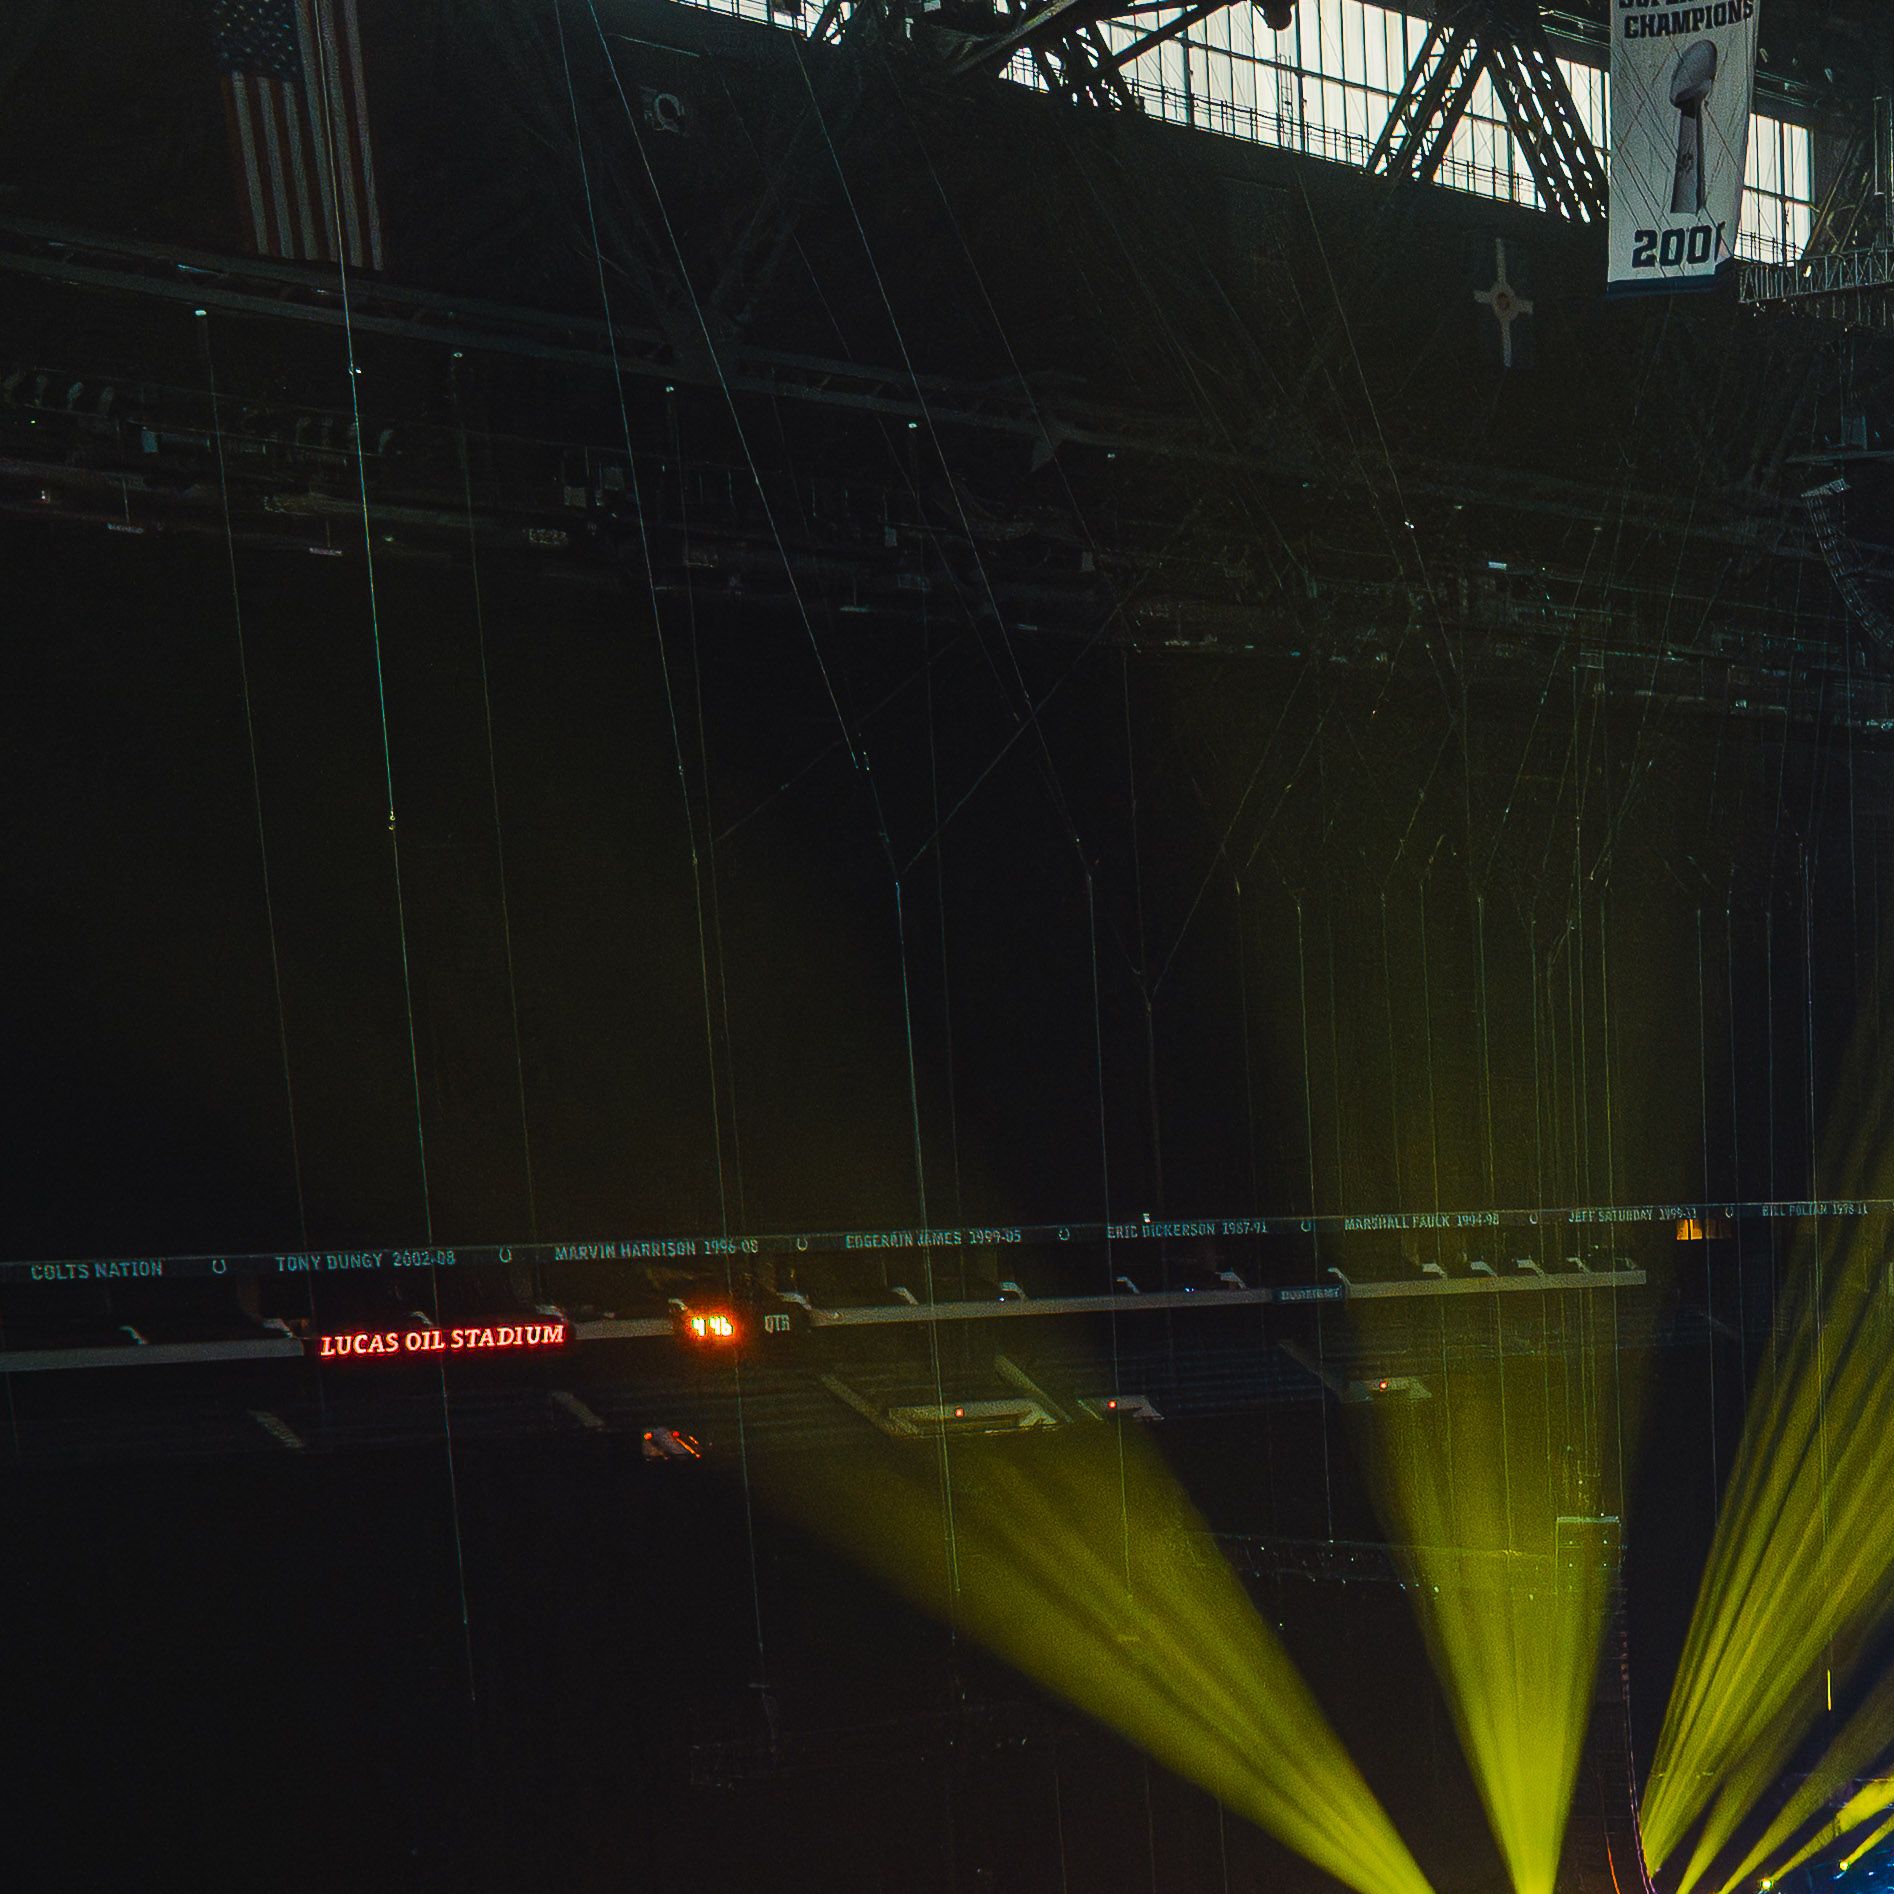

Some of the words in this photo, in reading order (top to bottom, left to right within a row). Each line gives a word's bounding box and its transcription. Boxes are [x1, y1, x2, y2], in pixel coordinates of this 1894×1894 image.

[1344, 1215, 1408, 1231] MARSHALL
[1412, 1213, 1450, 1228] FAULK
[1598, 1206, 1654, 1222] SATURDAY
[845, 1231, 914, 1249] EDGERRIN
[917, 1230, 961, 1247] JAMES
[1106, 1223, 1138, 1240] ERIC
[1142, 1221, 1216, 1239] DICKERSON
[554, 1244, 616, 1262] MARVIN
[620, 1241, 697, 1260] HARRISON
[30, 1263, 89, 1281] COLTS
[95, 1259, 162, 1279] NATION
[275, 1254, 321, 1273] TONY
[326, 1252, 383, 1271] DUNGY
[320, 1331, 399, 1356] LUCAS
[405, 1329, 445, 1350] OIL
[451, 1325, 564, 1349] STADIUM
